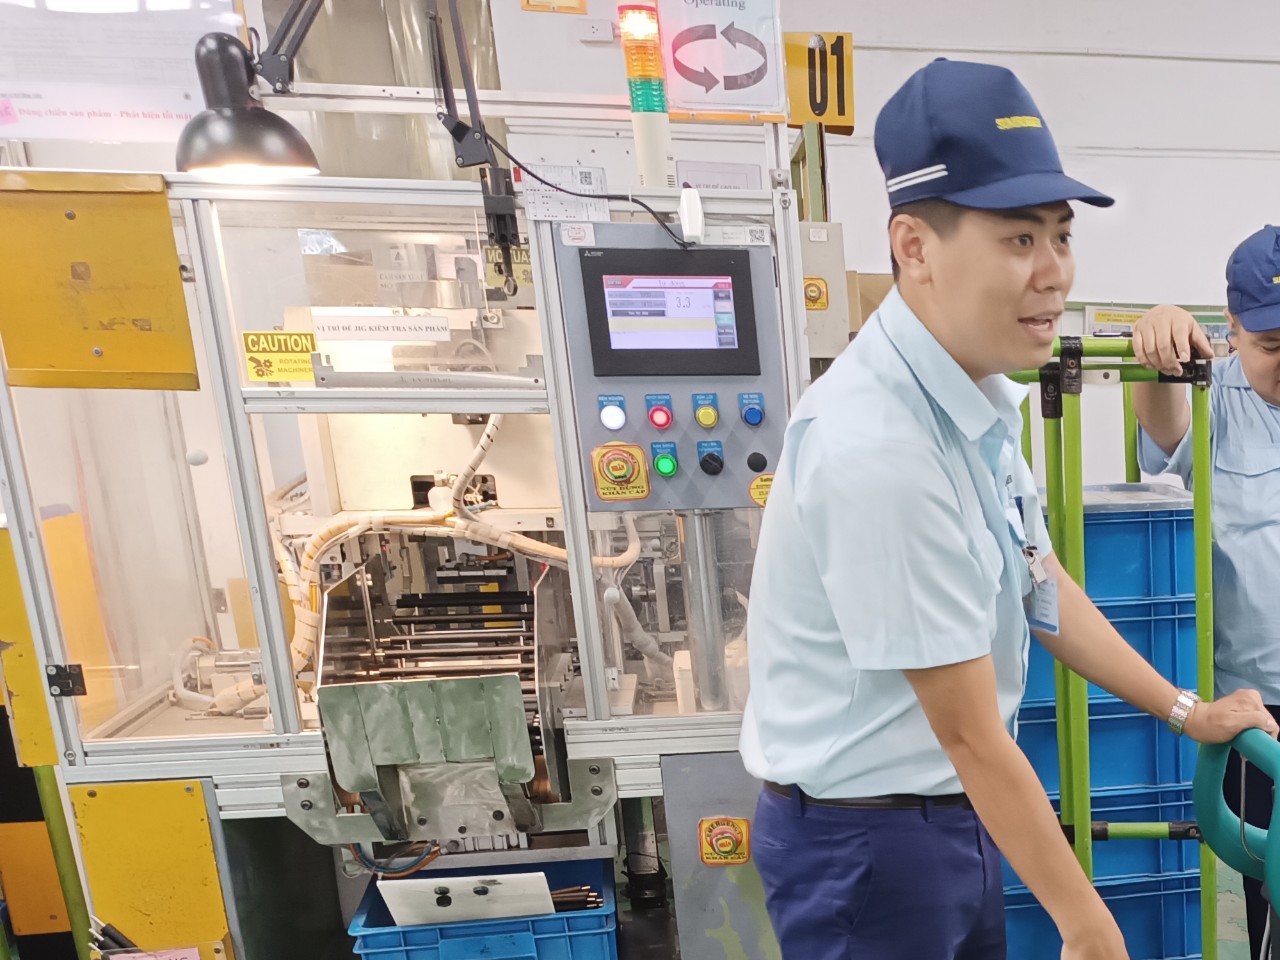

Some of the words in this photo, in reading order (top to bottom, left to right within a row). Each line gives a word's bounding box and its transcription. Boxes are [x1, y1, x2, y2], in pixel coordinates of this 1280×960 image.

[807, 34, 846, 117] 01
[676, 296, 691, 308] 3.3
[354, 325, 367, 333] JIG
[391, 325, 407, 333] TRA
[248, 334, 313, 352] CAUTION
